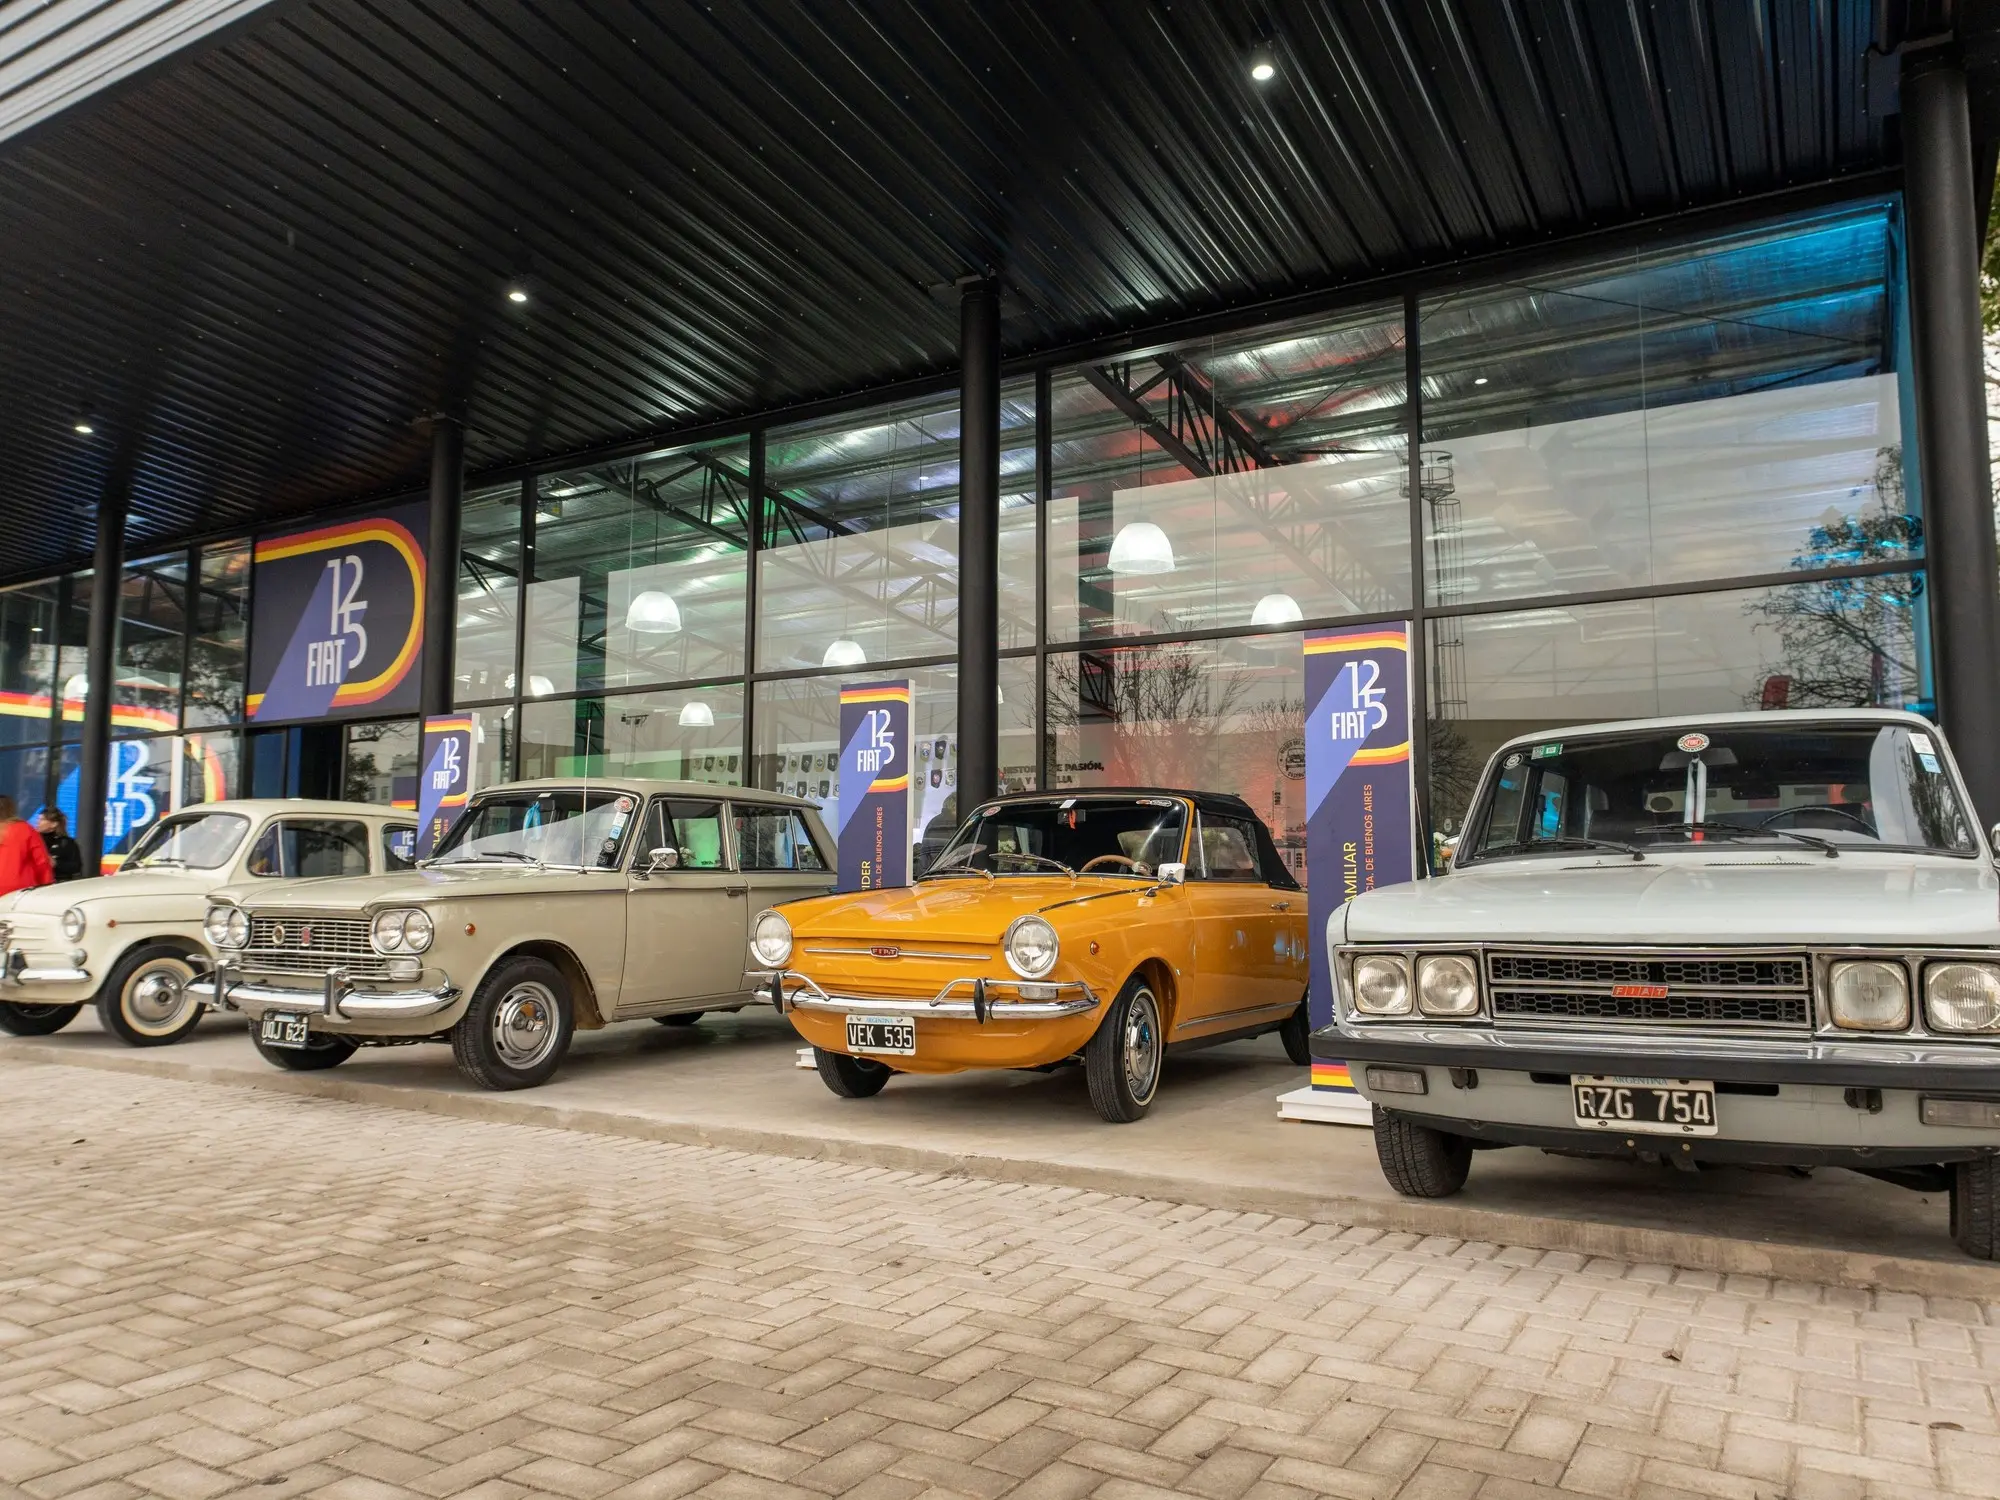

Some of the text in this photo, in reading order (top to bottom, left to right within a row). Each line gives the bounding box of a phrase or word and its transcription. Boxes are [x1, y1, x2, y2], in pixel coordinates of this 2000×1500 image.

[306, 638, 346, 687] FIAT
[1331, 710, 1367, 740] FIAT
[857, 749, 882, 772] FIAT
[1064, 760, 1105, 772] PASIÓN,
[432, 770, 452, 790] FIAT
[875, 831, 883, 863] BUENOS
[1363, 784, 1374, 892] CIA. DE BUENOS AIRES
[861, 860, 871, 889] IDER
[875, 863, 882, 875] DE
[1343, 842, 1357, 902] AMILIAR
[871, 948, 896, 956] FIAT
[1614, 986, 1666, 997] FIAT
[285, 1022, 307, 1042] 623
[848, 1024, 913, 1048] VEK 535
[1612, 1076, 1669, 1086] ARGENTINA
[1578, 1086, 1711, 1124] RZG 754
